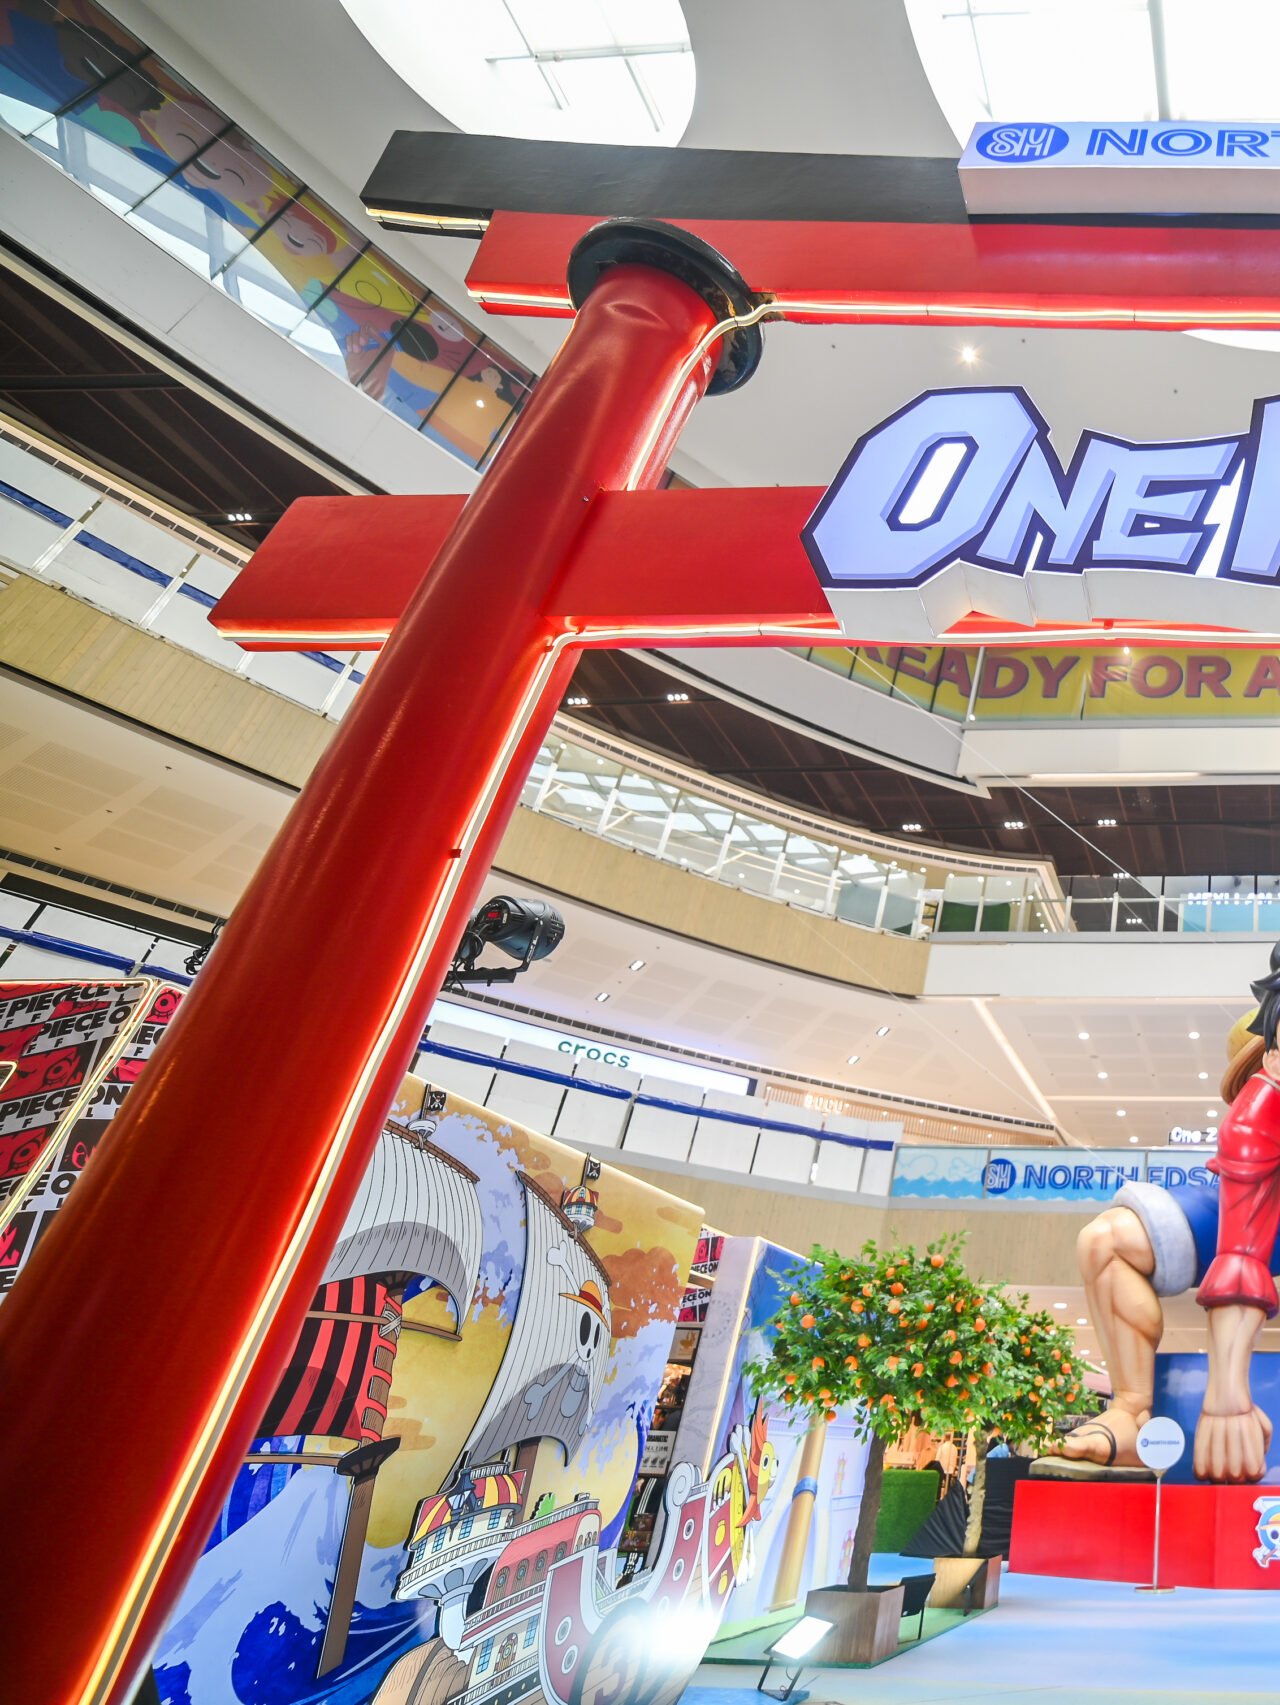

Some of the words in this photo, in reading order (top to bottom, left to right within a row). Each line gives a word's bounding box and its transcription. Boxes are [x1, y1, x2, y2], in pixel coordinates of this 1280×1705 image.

[802, 386, 1246, 585] ONE
[1088, 655, 1232, 699] FOR
[558, 1040, 630, 1068] crocs
[1022, 1165, 1139, 1190] NORTH
